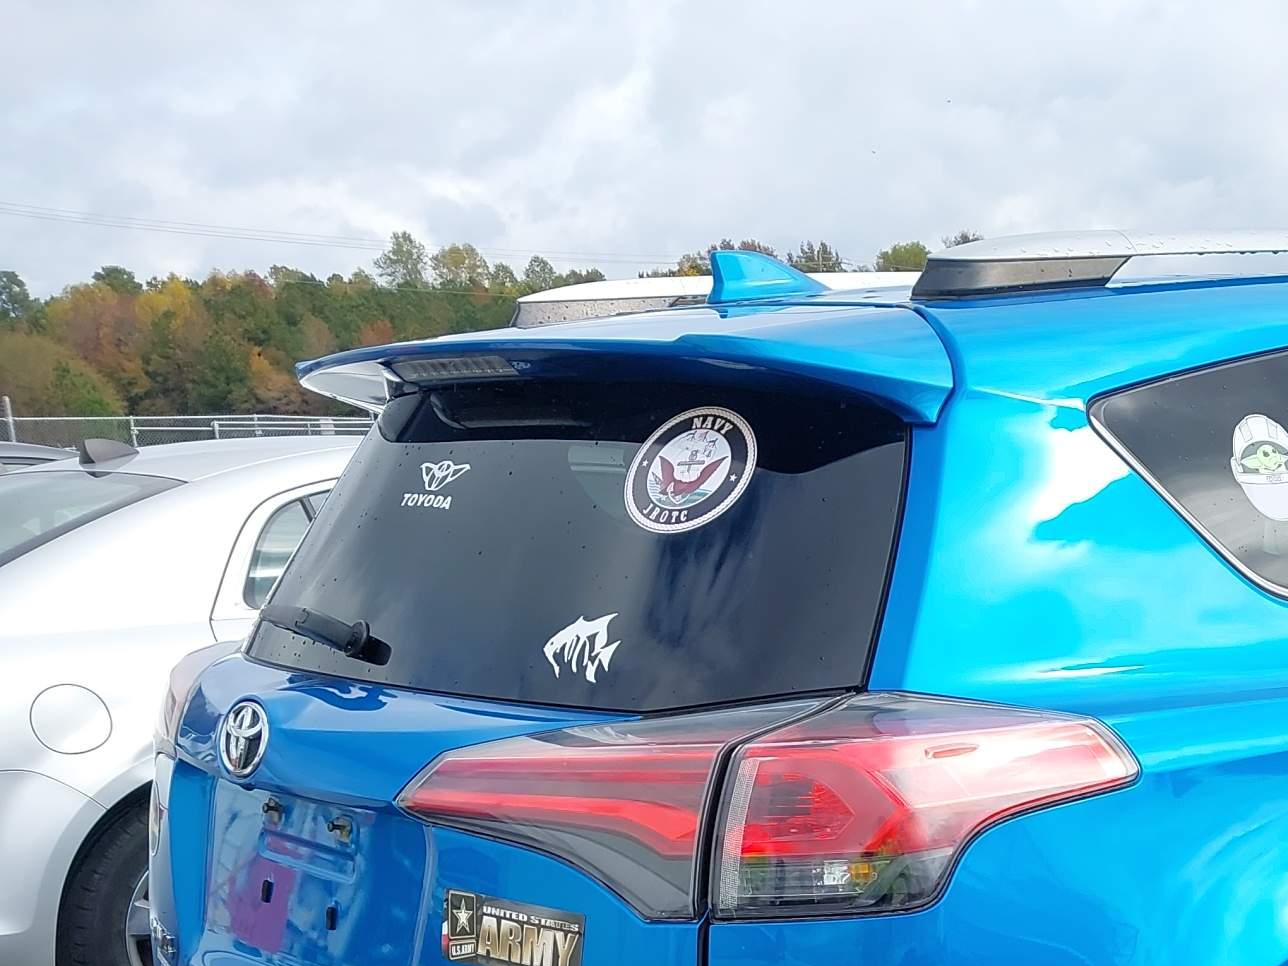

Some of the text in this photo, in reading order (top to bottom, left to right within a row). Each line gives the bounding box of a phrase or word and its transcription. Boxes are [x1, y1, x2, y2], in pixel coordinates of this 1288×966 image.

[691, 416, 734, 434] NAVY
[400, 493, 452, 510] TOYODA
[642, 503, 688, 523] JROTC
[483, 905, 579, 932] UNITED STATES
